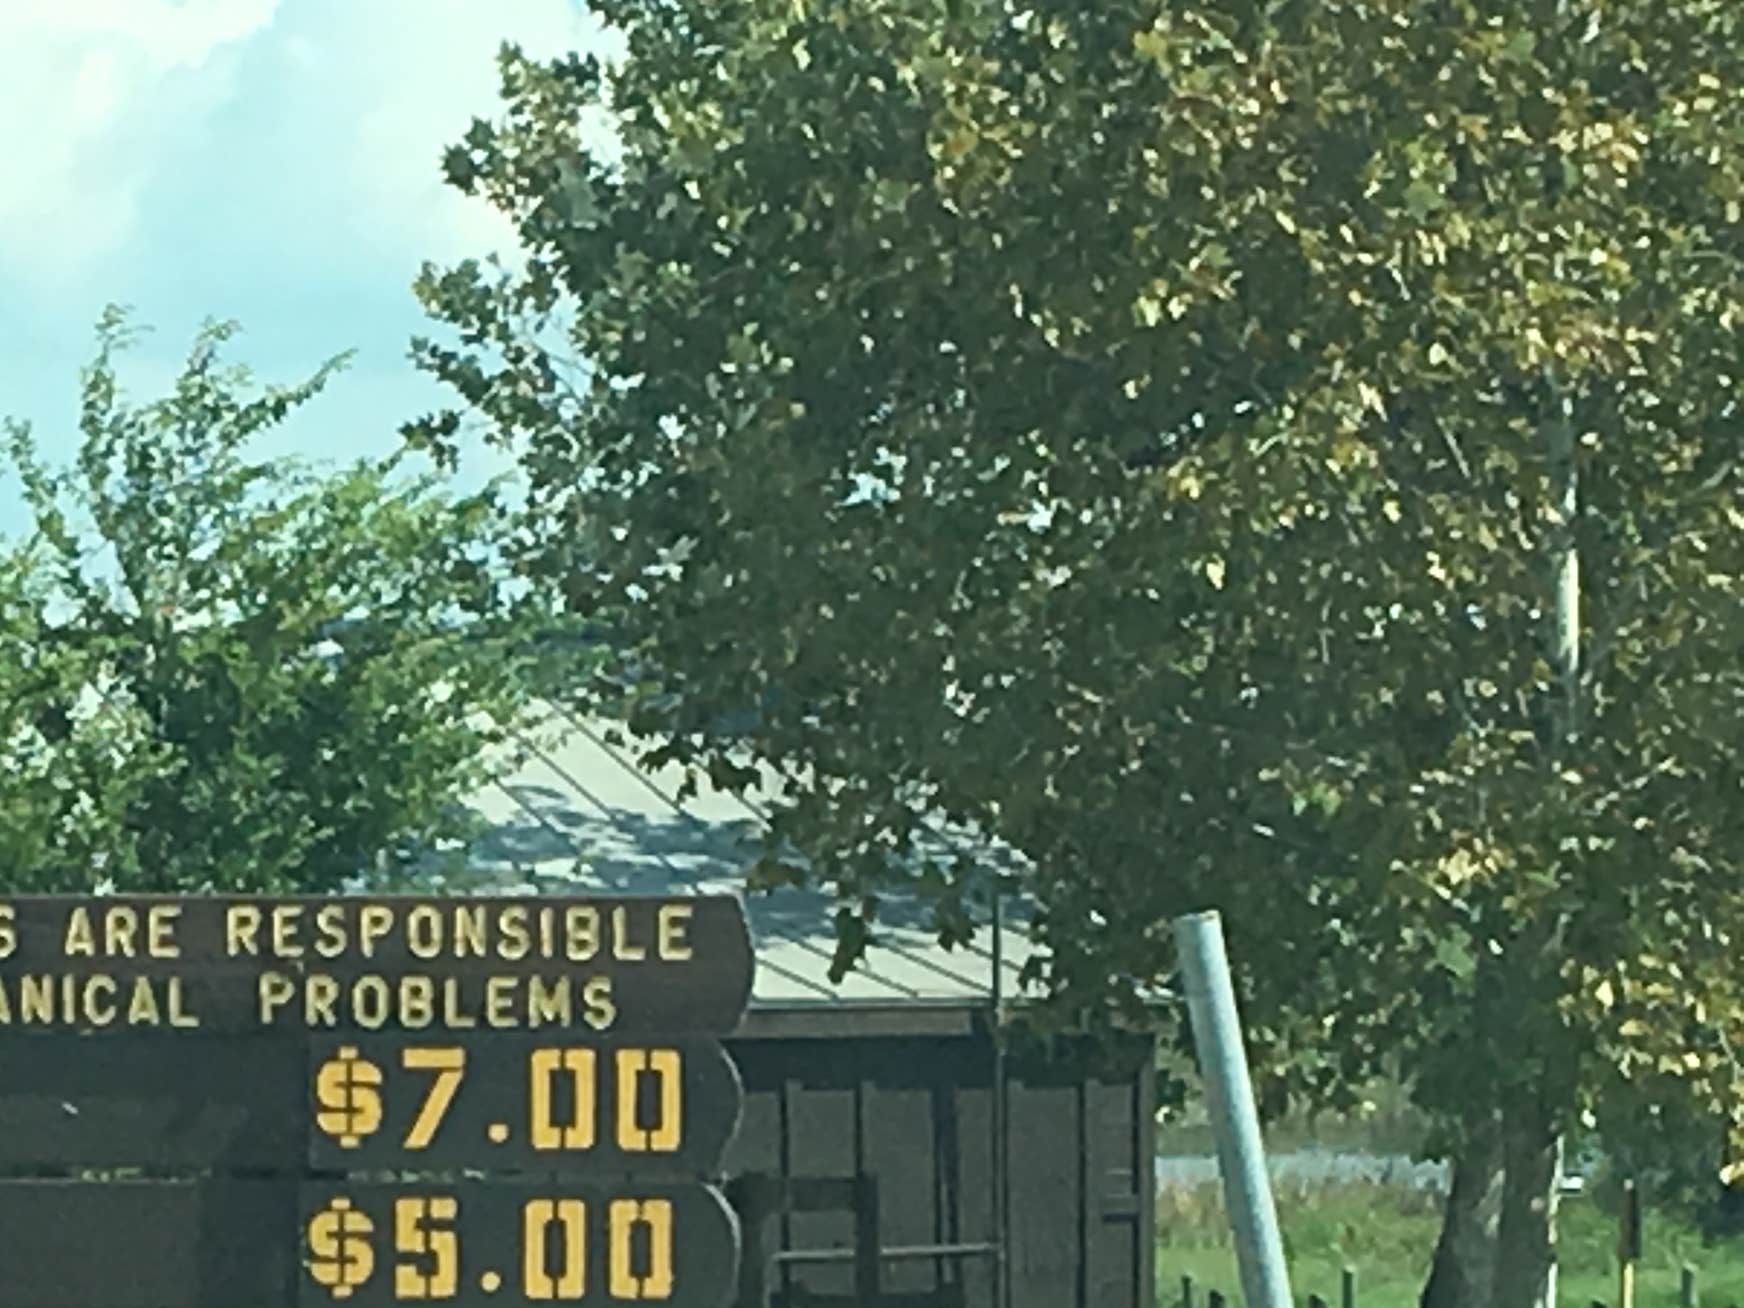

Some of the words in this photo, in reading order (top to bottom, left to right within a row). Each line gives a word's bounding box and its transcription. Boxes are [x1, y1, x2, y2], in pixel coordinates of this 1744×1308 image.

[64, 905, 181, 958] ARE
[226, 906, 693, 960] RESPONSIBLE
[259, 975, 617, 1030] PROBLEMS
[316, 1045, 682, 1152] $7.00
[307, 1197, 673, 1299] $5.00
